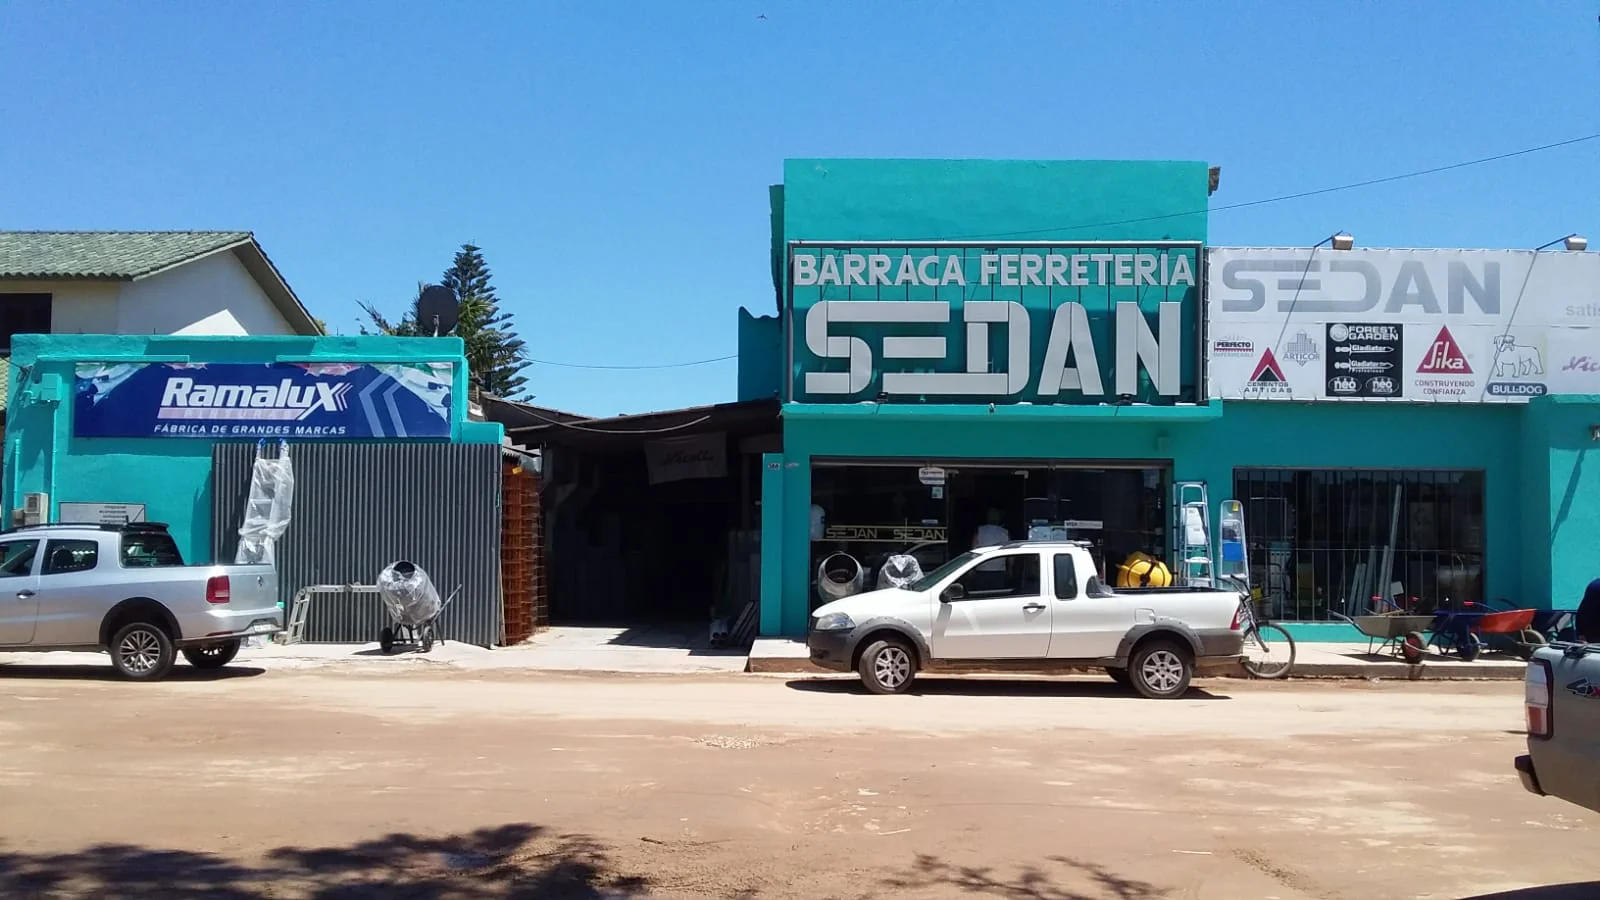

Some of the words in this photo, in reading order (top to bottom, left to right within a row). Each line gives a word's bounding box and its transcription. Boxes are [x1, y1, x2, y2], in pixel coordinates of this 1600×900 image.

[793, 254, 965, 286] BARRACA
[980, 254, 1195, 287] FERRETERIA
[1222, 259, 1501, 315] SEDAN
[1566, 303, 1600, 317] sati
[805, 300, 1182, 396] SEDAN
[1283, 353, 1320, 361] ARTICOR
[1424, 341, 1464, 369] Sika
[1562, 356, 1600, 372] Nic
[160, 377, 346, 420] Ramalux
[154, 424, 206, 433] FÁBRICA
[231, 426, 290, 434] GRANDES
[295, 426, 346, 434] MARCAS
[826, 528, 877, 539] SEDAN
